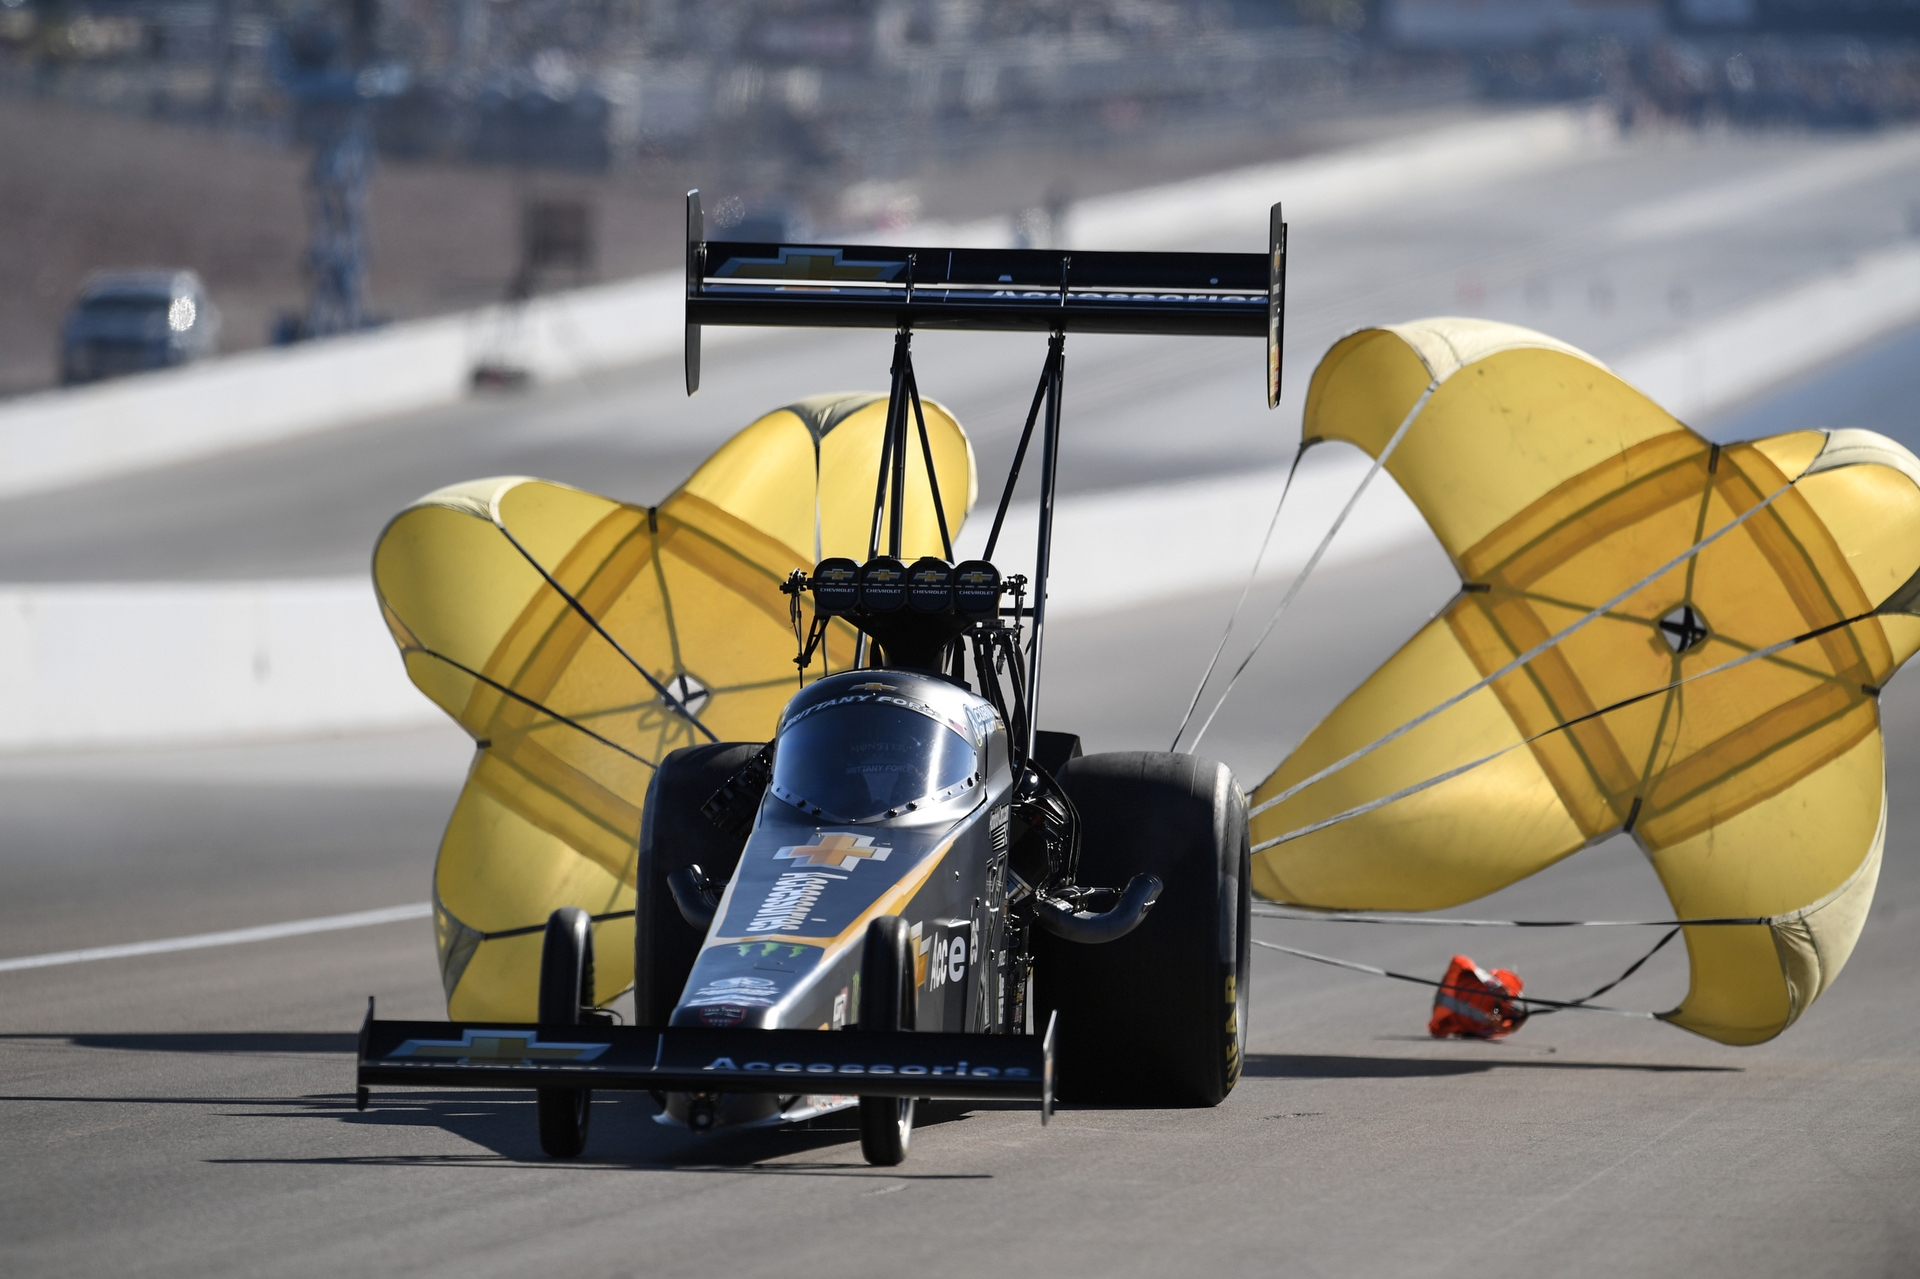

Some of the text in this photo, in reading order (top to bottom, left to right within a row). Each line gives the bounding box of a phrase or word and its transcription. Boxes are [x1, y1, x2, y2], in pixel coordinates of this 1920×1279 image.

[784, 694, 943, 729] BRITTANY FORCE
[845, 765, 884, 775] BRITTANY
[746, 872, 848, 932] Accessories
[702, 1056, 1031, 1077] Accessories
